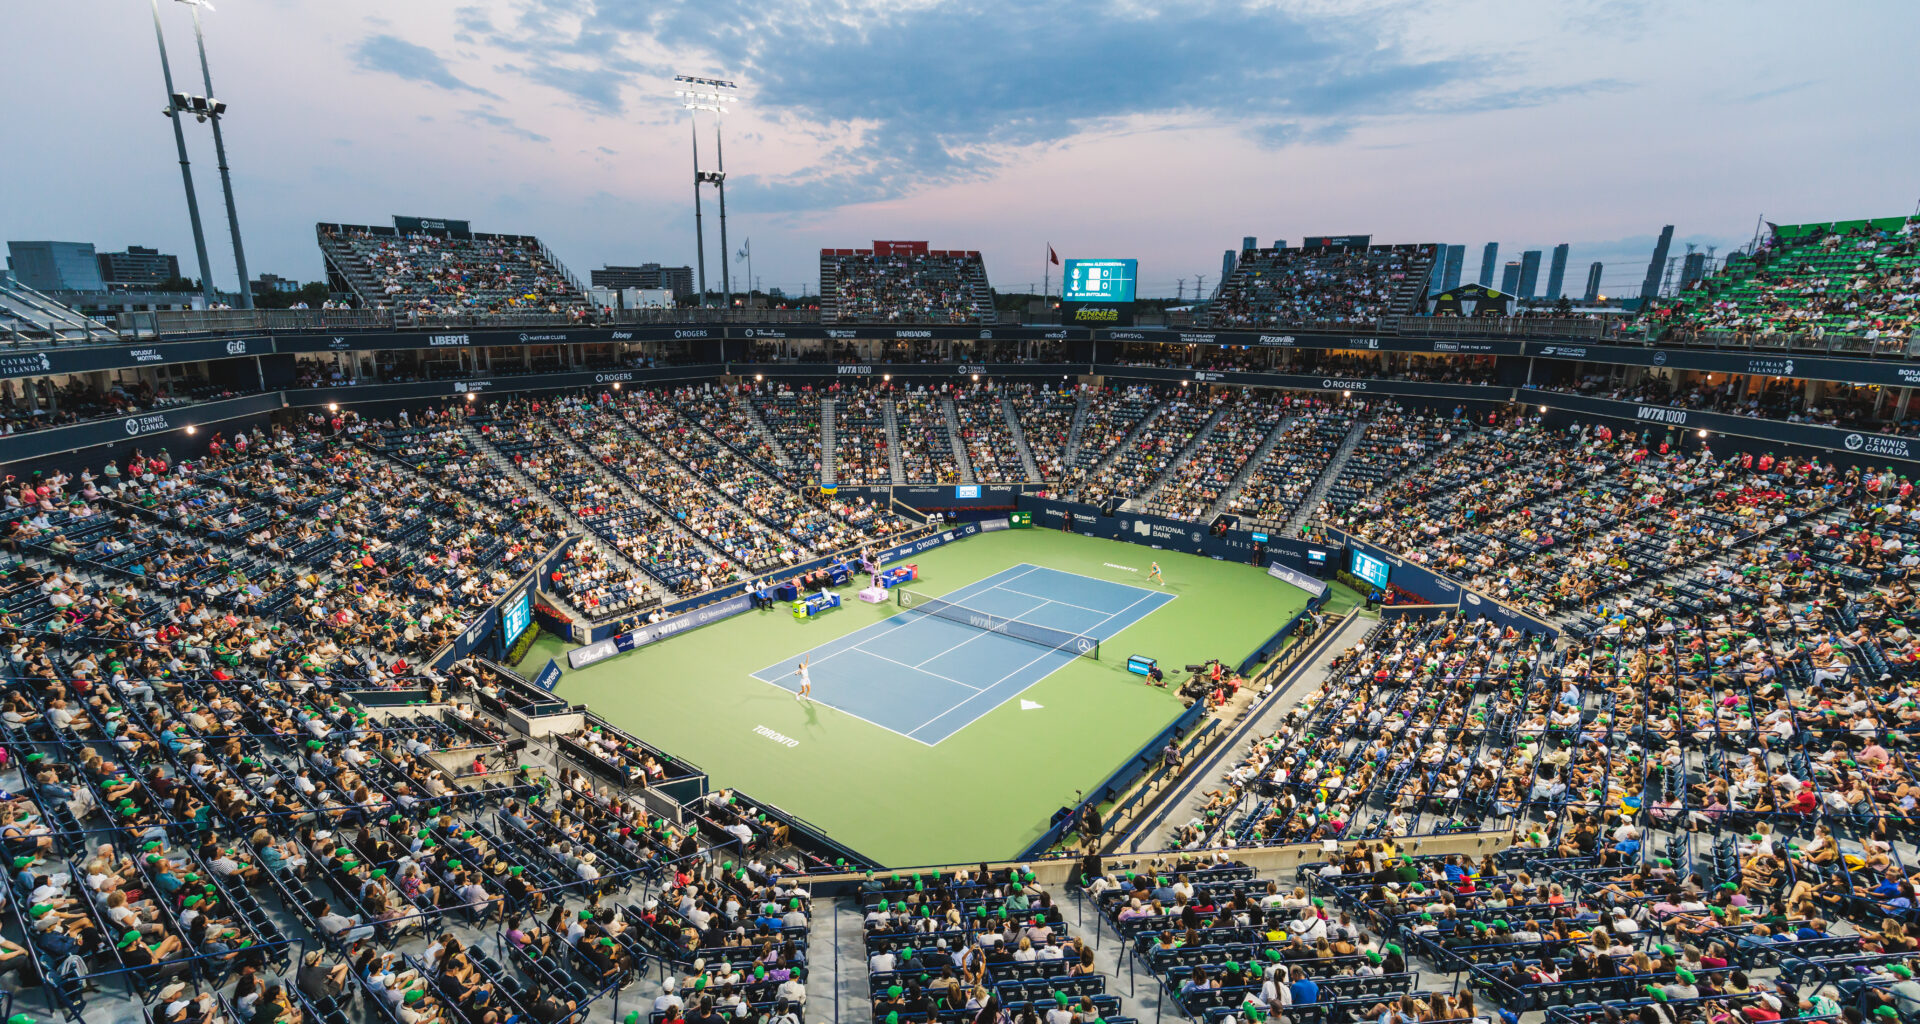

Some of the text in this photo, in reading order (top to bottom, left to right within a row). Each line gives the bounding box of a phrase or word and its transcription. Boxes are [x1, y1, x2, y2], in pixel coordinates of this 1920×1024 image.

[682, 329, 708, 337] ROGERS
[896, 330, 932, 338] BARBADOS
[1259, 335, 1295, 344] Pizzaville
[1435, 343, 1457, 351] Hilton
[1, 356, 39, 366] CAYMAN
[1749, 360, 1784, 368] CAYMAN
[3, 364, 41, 374] ISLANDS
[604, 372, 632, 381] ROGERS
[1332, 380, 1367, 390] ROGERS
[139, 414, 164, 423] TENNIS
[141, 422, 169, 433] CANADA
[1868, 436, 1907, 449] TENNIS
[1865, 444, 1910, 457] CANADA
[1152, 524, 1186, 535] NATIONAL
[921, 537, 940, 549] ROGERS
[965, 525, 976, 534] CGI
[1152, 530, 1172, 540] BANK
[1497, 605, 1510, 616] SKS
[578, 645, 607, 664] Lindt
[752, 724, 800, 749] TORONTO
